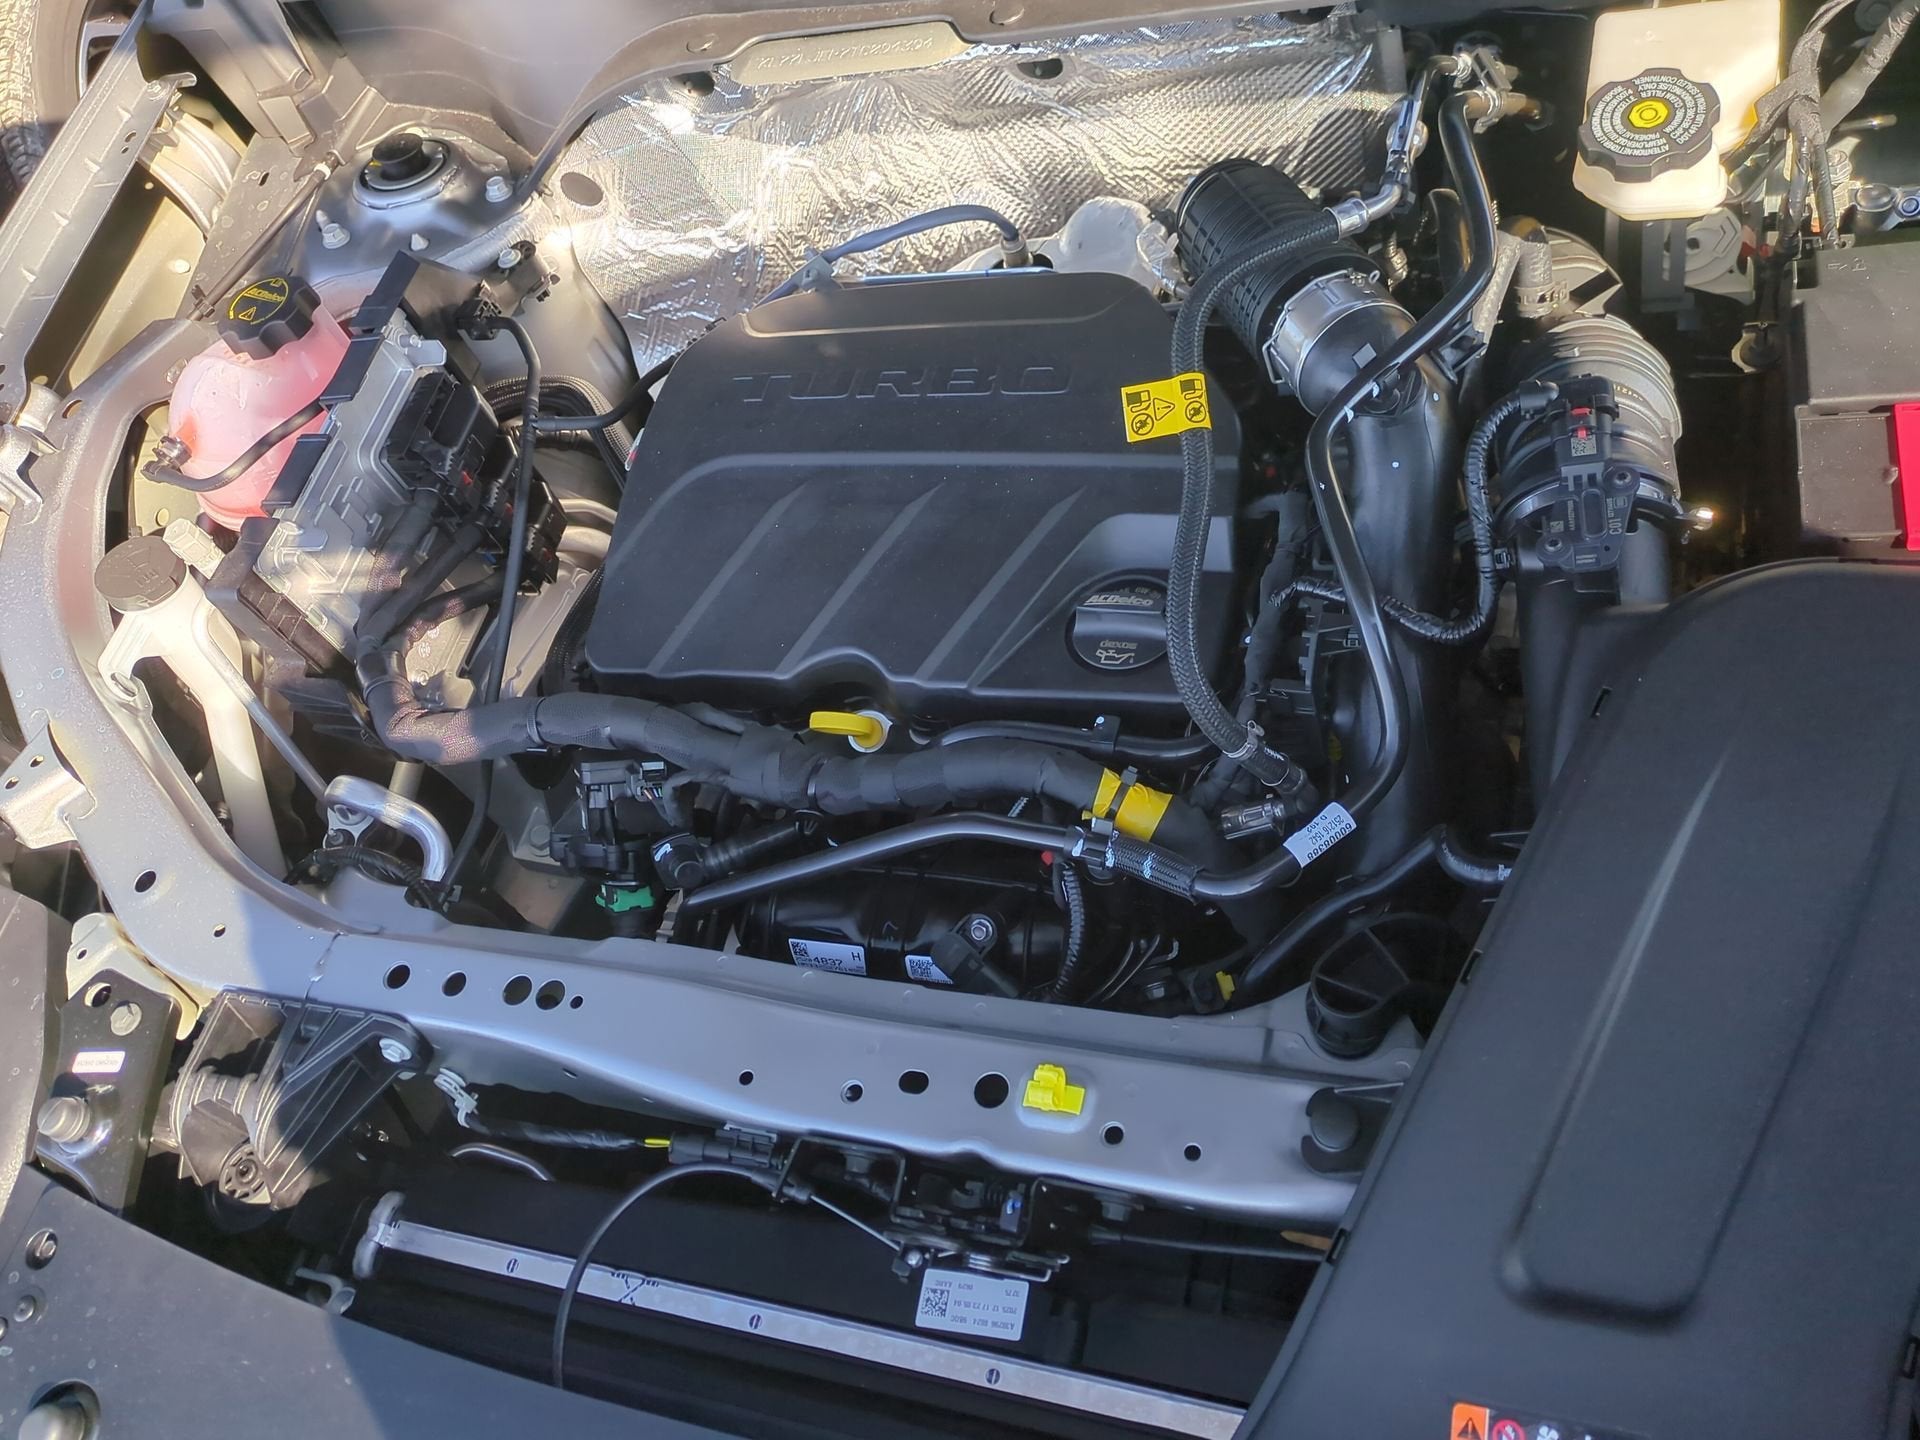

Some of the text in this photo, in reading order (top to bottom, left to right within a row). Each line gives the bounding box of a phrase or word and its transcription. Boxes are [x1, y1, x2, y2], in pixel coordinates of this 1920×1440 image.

[1638, 82, 1657, 92] ONLY
[1657, 82, 1672, 91] USE
[1676, 79, 1700, 95] SEALED
[1640, 89, 1666, 98] FILLER
[1664, 92, 1683, 107] CLEAN
[1690, 113, 1706, 131] FLUID
[1676, 131, 1692, 145] DOT
[732, 367, 1072, 402] TURBO
[1084, 594, 1154, 607] ACDelco
[1099, 640, 1139, 650] dexos
[851, 951, 861, 962] H
